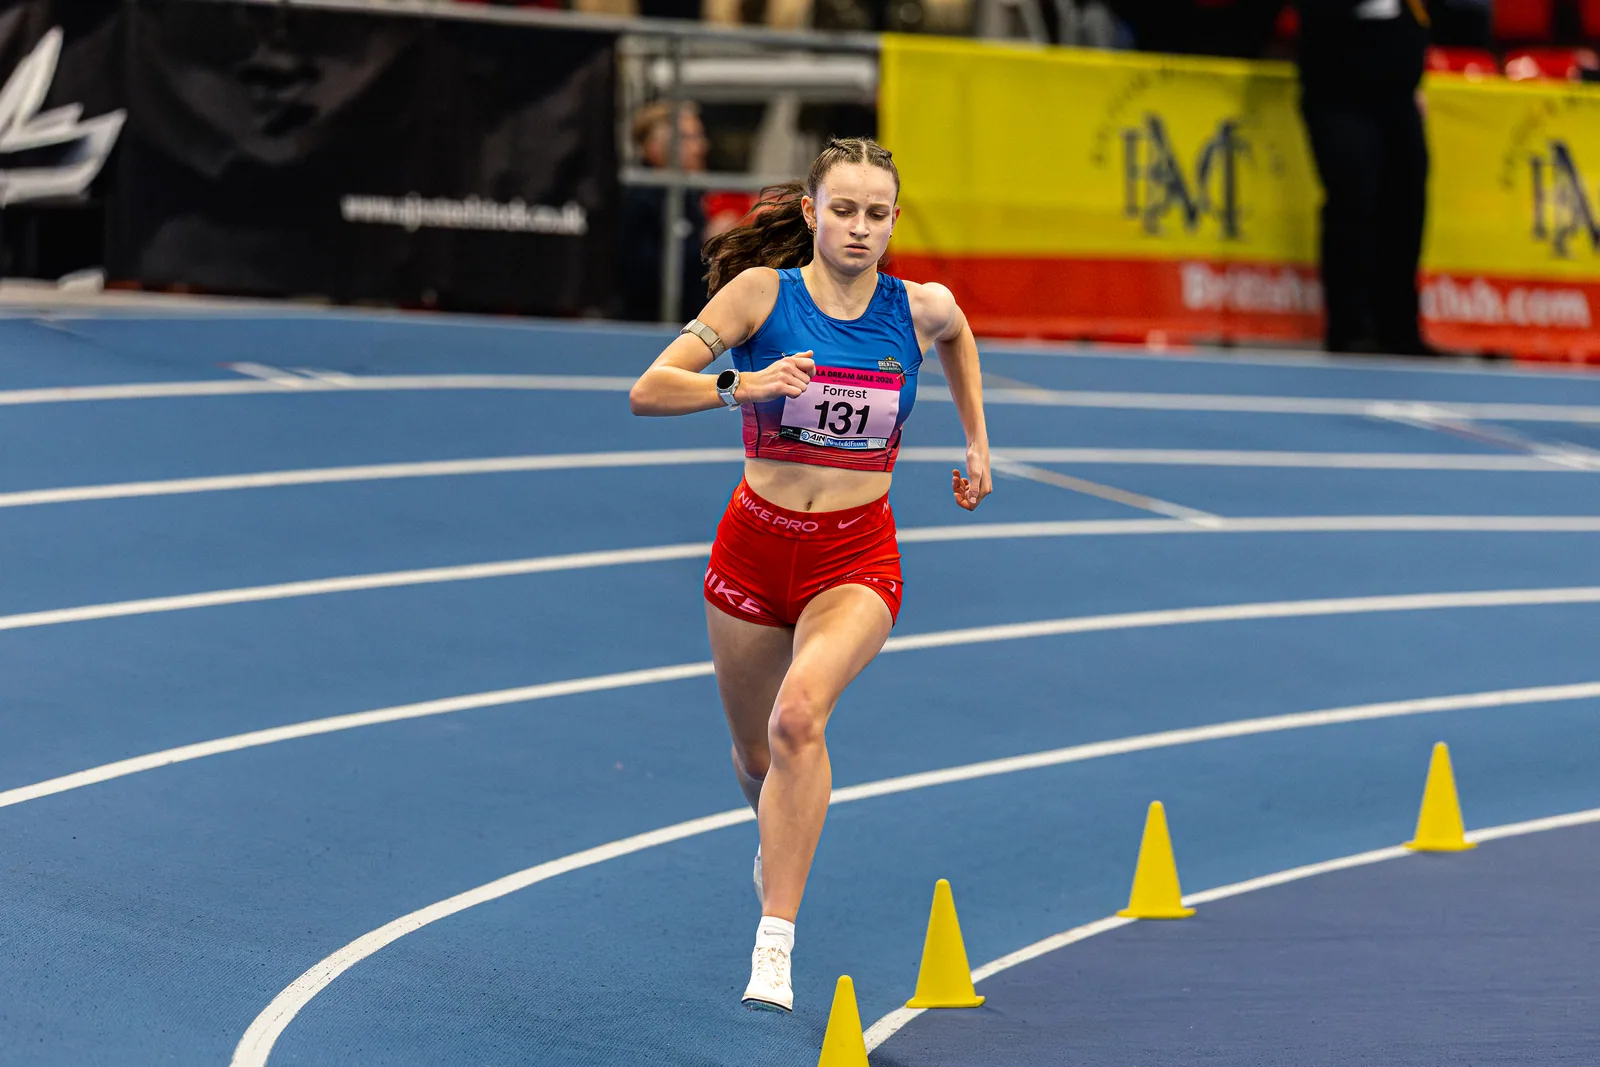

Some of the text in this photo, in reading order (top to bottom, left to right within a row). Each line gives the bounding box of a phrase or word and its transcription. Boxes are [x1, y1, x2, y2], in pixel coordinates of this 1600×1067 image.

[1418, 273, 1592, 329] club.com
[823, 385, 868, 399] Forrest
[827, 370, 855, 380] DREAM
[856, 374, 874, 382] MILE
[814, 400, 871, 435] 131
[739, 491, 819, 533] NIKE PRO
